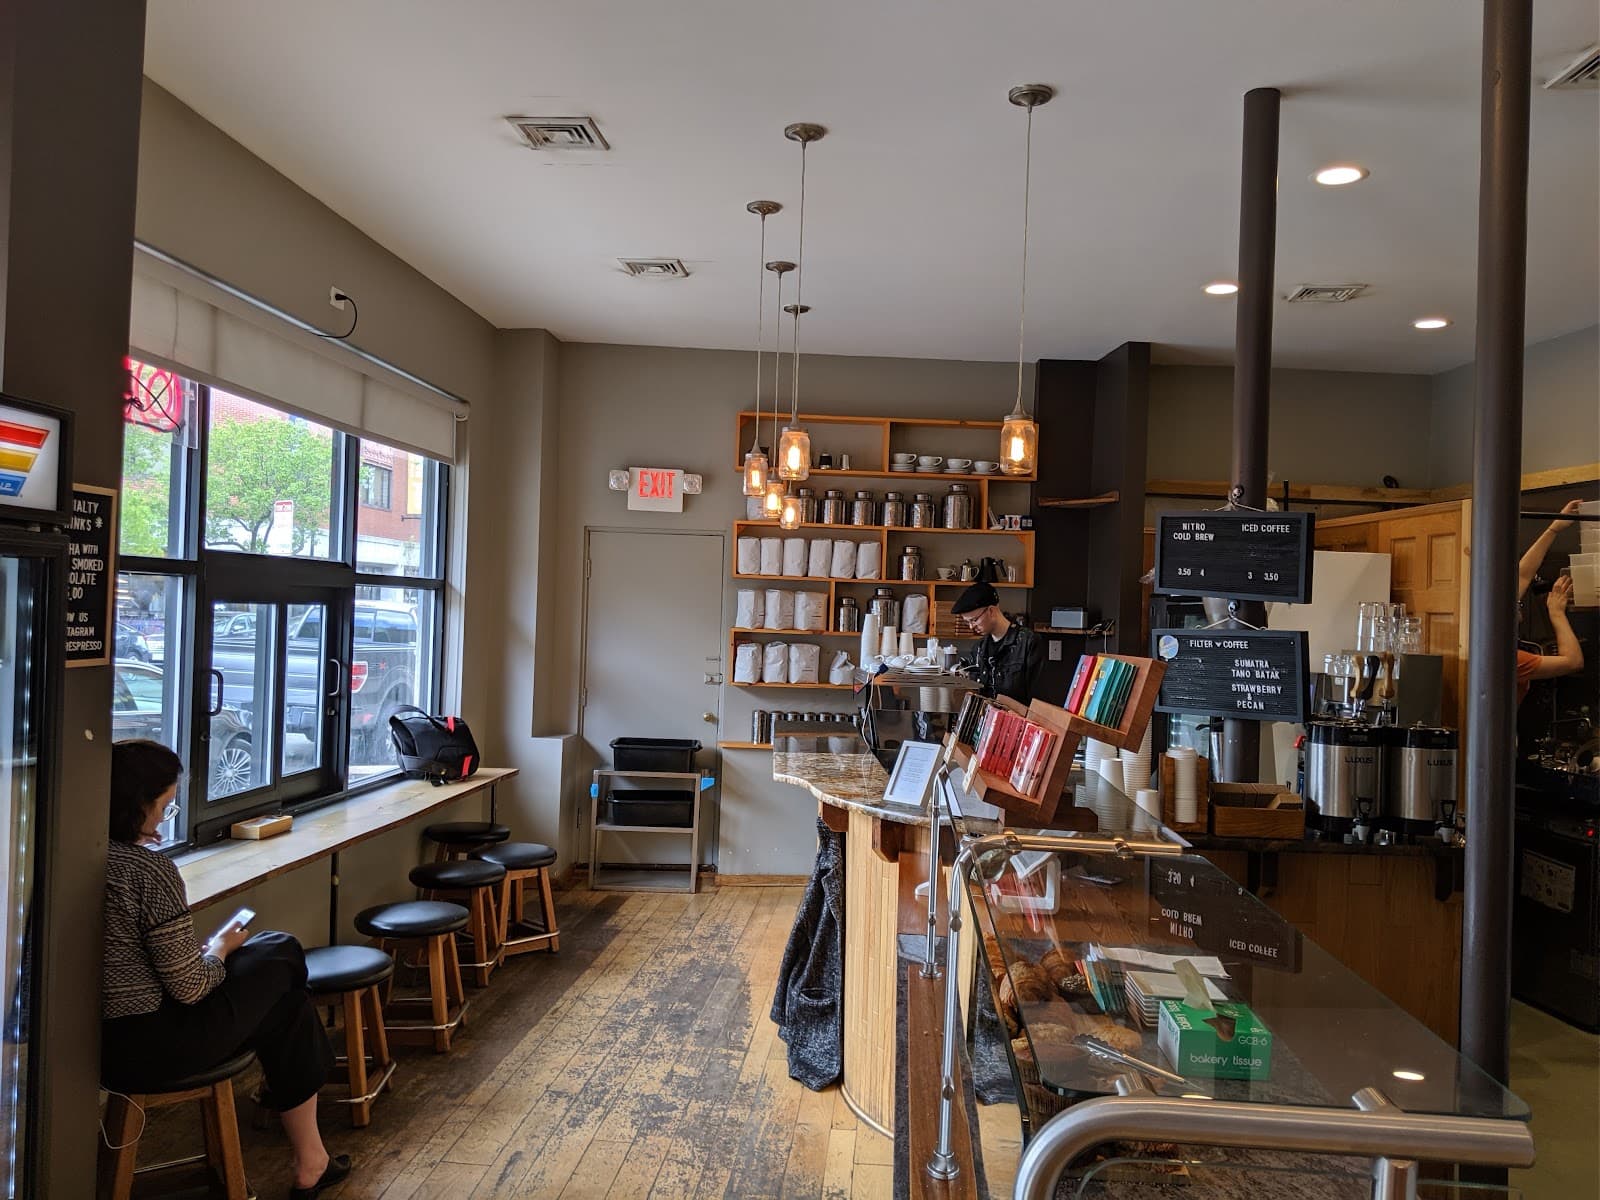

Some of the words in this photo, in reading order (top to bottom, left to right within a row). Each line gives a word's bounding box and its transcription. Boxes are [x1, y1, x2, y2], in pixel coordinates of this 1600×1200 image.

[639, 470, 676, 498] EXIT
[1182, 523, 1206, 531] NITRO
[1242, 524, 1258, 532] ICED
[1261, 525, 1290, 533] COFFEE
[1173, 532, 1191, 540] COLD
[1195, 533, 1214, 541] BREW
[82, 544, 98, 554] WITH
[71, 558, 103, 571] SMOKED
[1190, 640, 1213, 648] FILTER
[1223, 641, 1248, 649] COFFEE
[1235, 659, 1269, 668] SUMATRA
[1232, 669, 1251, 678] TANO
[1256, 670, 1280, 679] BATAK
[1232, 684, 1282, 694] STRAWBERRY
[1237, 701, 1264, 710] PECAN
[1190, 1053, 1228, 1066] bakery
[1233, 1056, 1262, 1066] tissue
